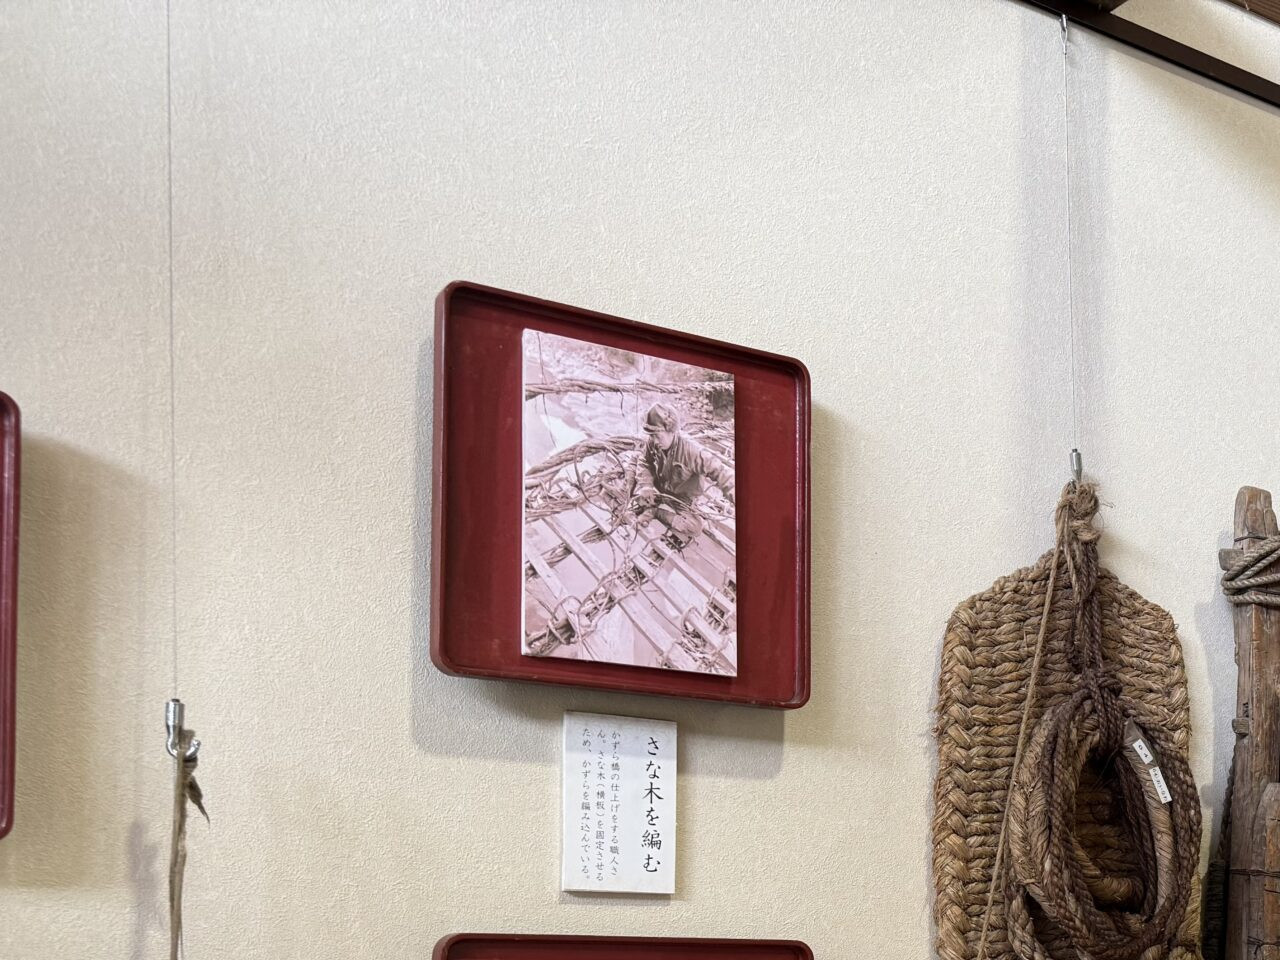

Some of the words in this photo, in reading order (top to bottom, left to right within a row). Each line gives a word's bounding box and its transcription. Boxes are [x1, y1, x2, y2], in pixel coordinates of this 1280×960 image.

[580, 728, 591, 879] ため、かずらを編み込んでいる。
[609, 731, 620, 876] かずら橋の仕上げをする職人さ
[641, 737, 664, 873] さな木を編む
